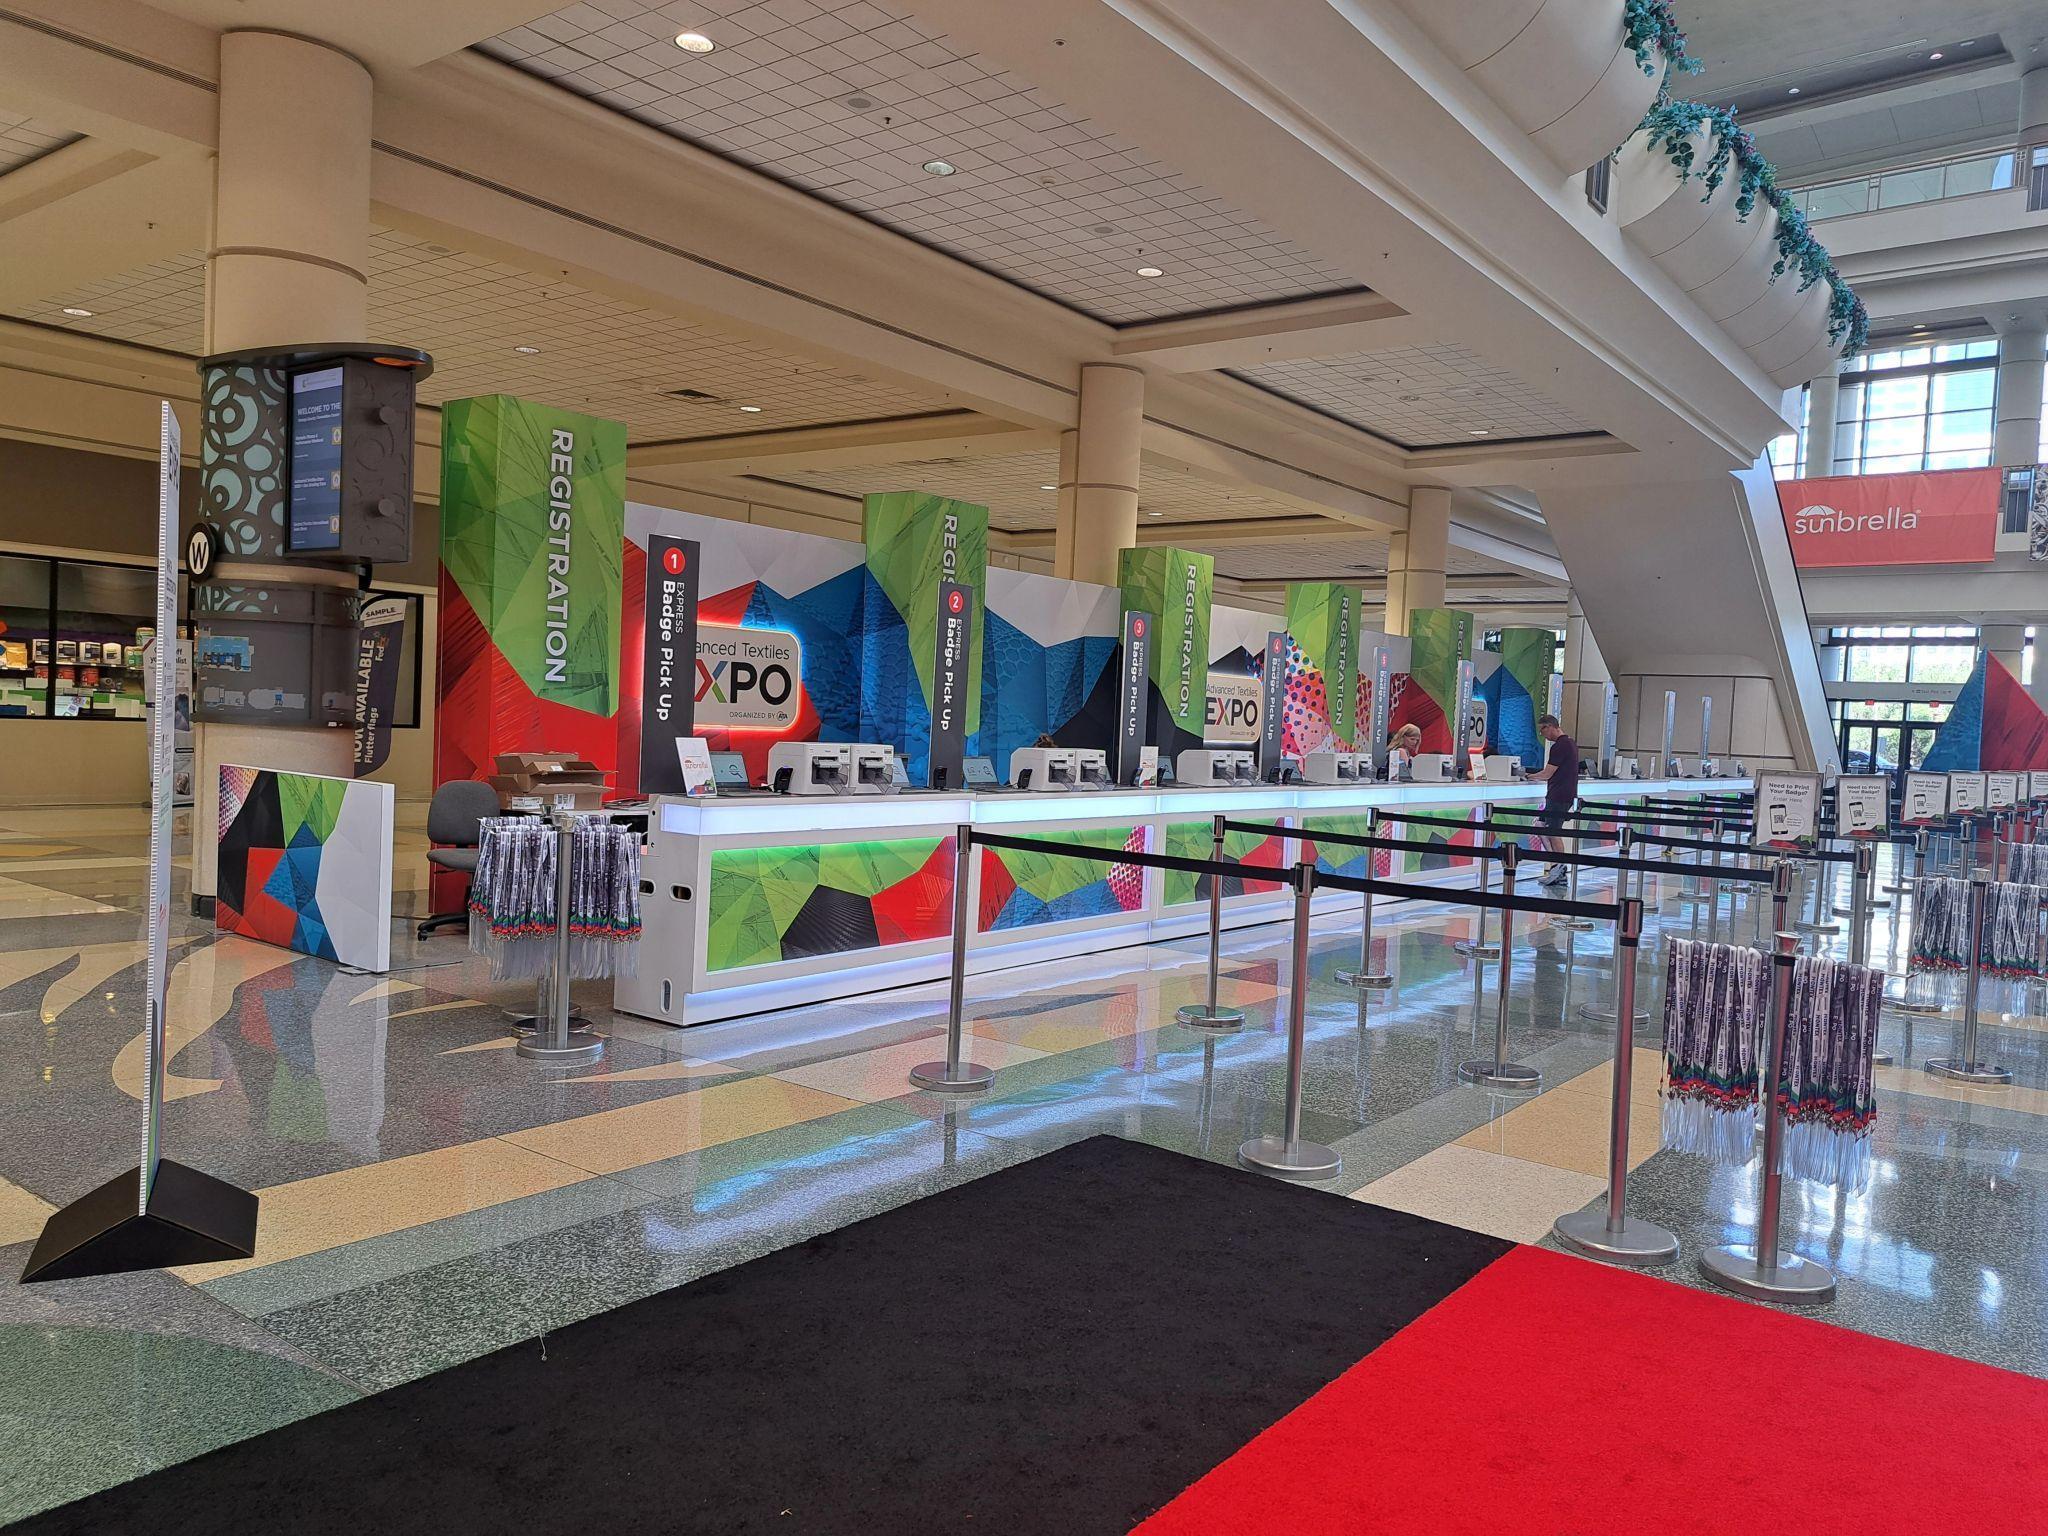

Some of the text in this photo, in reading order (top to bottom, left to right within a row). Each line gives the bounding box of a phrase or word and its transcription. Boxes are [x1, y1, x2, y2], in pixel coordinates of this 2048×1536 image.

[297, 402, 341, 416] WELCOME TO THE
[1794, 506, 1917, 534] sunbrella
[192, 542, 207, 569] W
[544, 428, 574, 682] REGISTRATION
[671, 553, 678, 569] 1
[366, 607, 396, 617] SAMPLE
[675, 582, 685, 634] EXPRESS
[952, 595, 960, 609] 2
[954, 619, 962, 660] EXPRESS
[1136, 622, 1142, 633] 3
[1179, 564, 1197, 717] REGISTRATION
[656, 580, 676, 721] Badge Pick Up
[741, 642, 790, 660] Textiles
[1335, 596, 1349, 725] REGISTRATION
[355, 639, 375, 723] AVAILABLE
[693, 658, 792, 705] XPO
[940, 617, 956, 731] Badge Pick Up
[1127, 641, 1140, 737] Badge Pick Up
[1206, 684, 1258, 697] Advanced Textiles
[1270, 657, 1278, 694] Badge
[1540, 638, 1550, 718] REGISTRATI
[729, 711, 766, 719] ORGANIZED
[1204, 697, 1258, 727] EXPO
[364, 707, 378, 764] Flutter flags
[1267, 724, 1274, 740] Up
